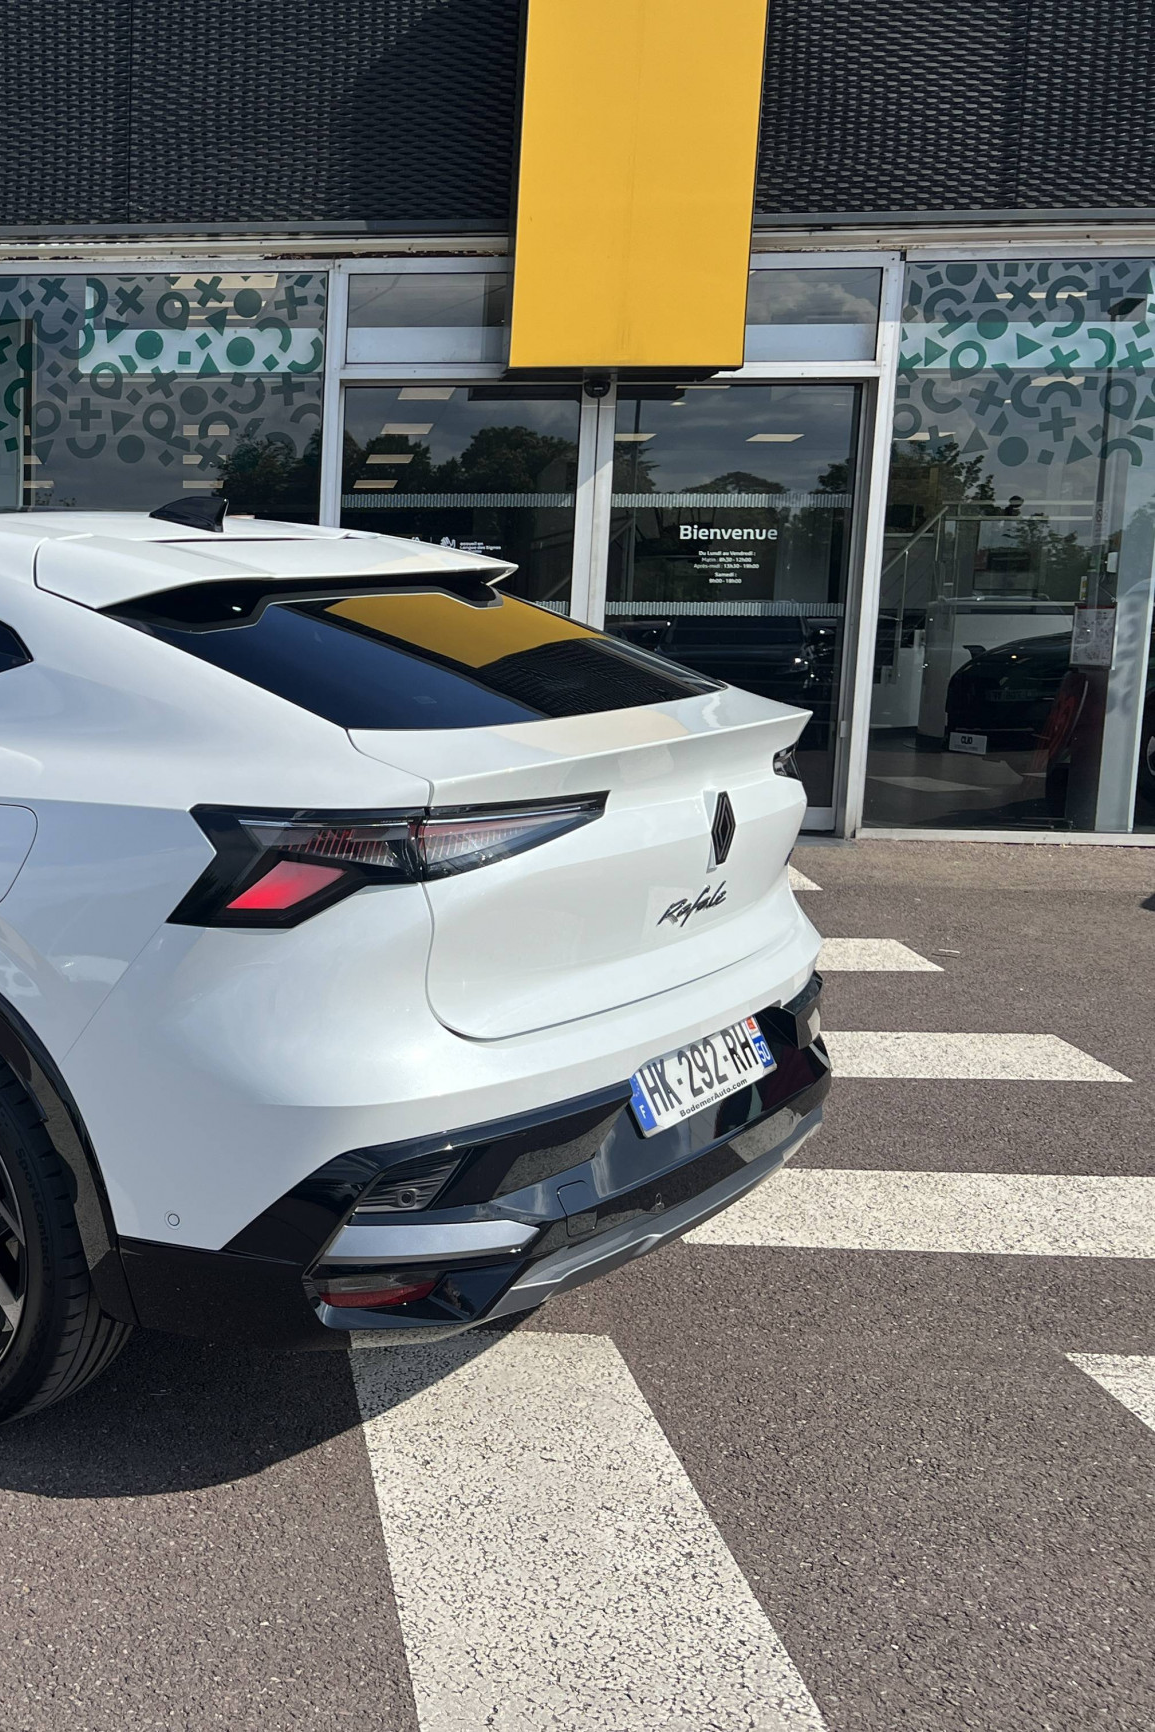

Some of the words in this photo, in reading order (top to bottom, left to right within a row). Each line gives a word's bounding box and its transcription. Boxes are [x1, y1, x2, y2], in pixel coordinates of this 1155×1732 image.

[679, 524, 778, 541] Bienvenue
[960, 735, 973, 745] CLIO
[656, 880, 727, 928] Rafale
[755, 1042, 772, 1063] 50
[679, 1077, 748, 1118] BodemerAuto.com
[638, 1105, 647, 1119] F
[14, 1147, 51, 1273] SportContact
